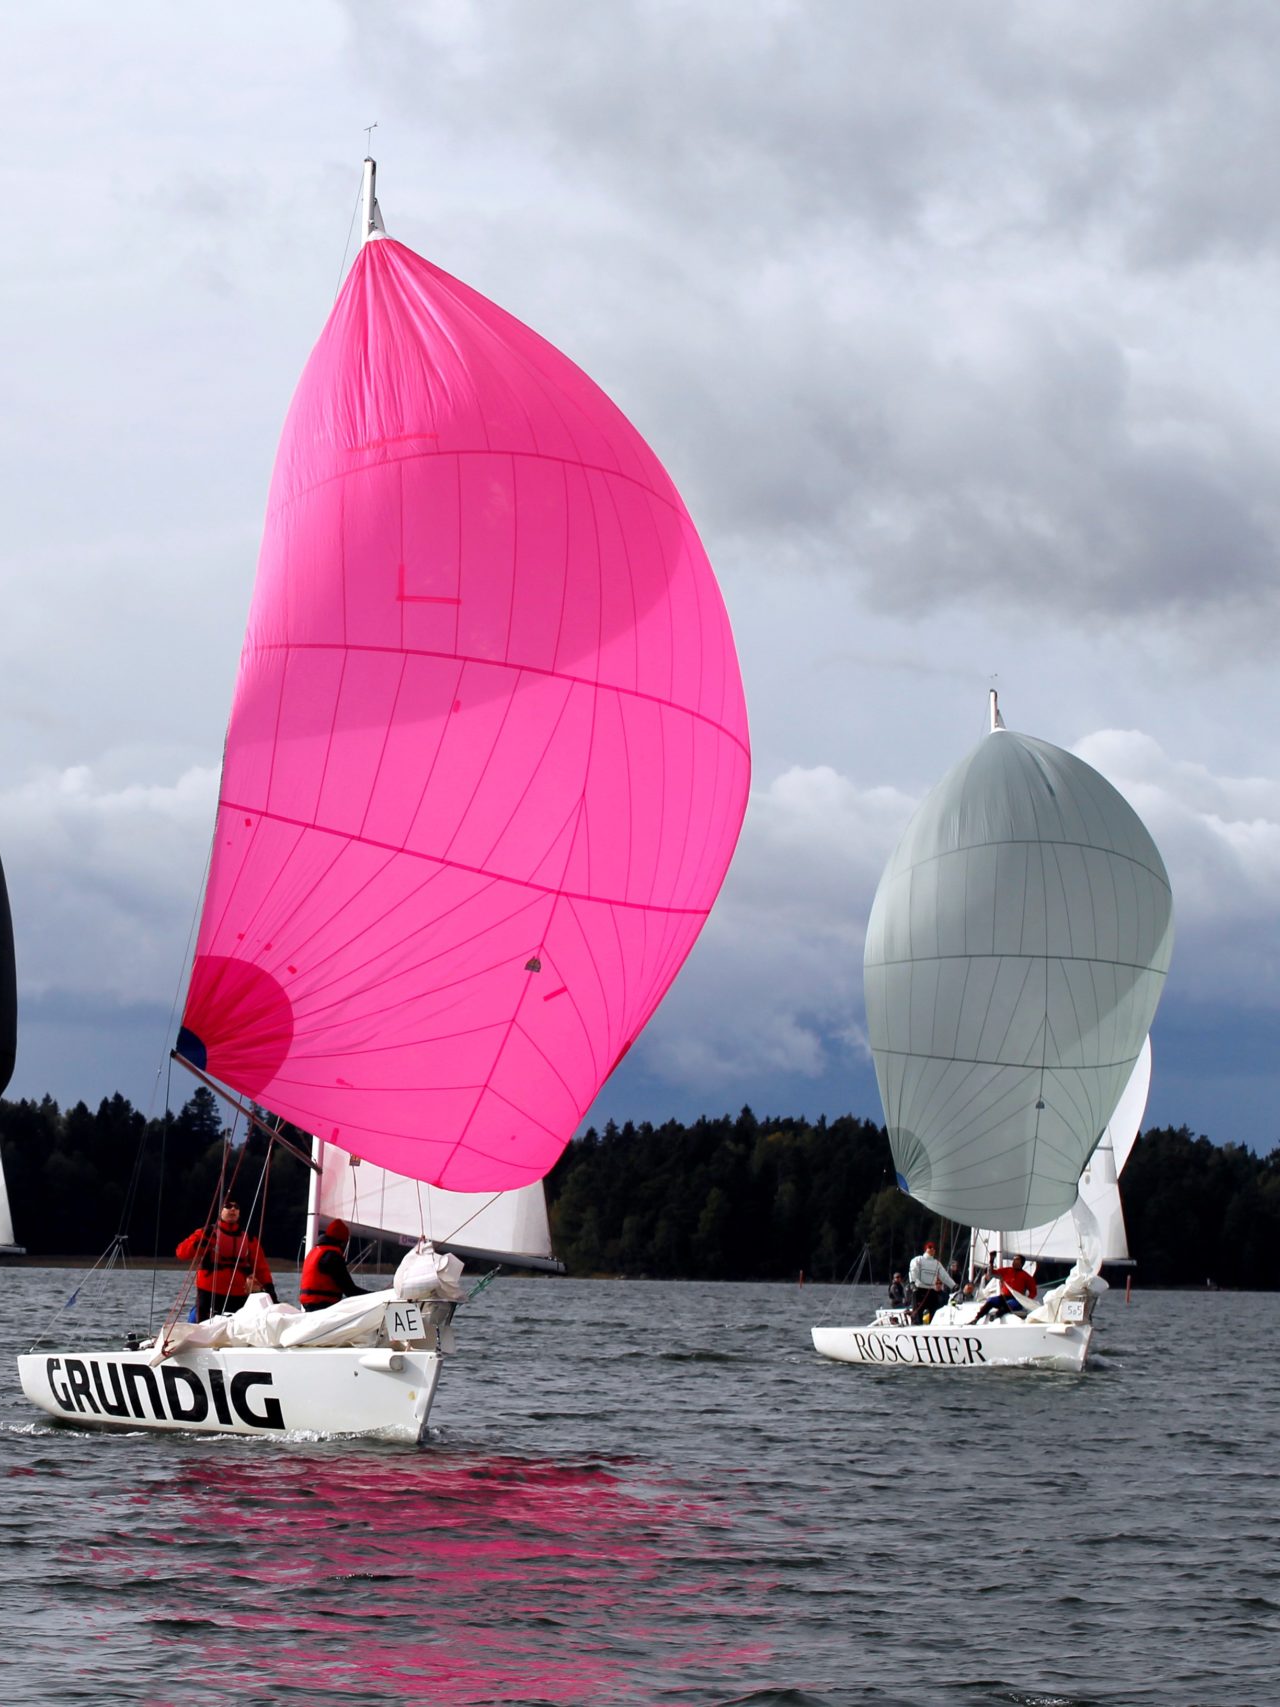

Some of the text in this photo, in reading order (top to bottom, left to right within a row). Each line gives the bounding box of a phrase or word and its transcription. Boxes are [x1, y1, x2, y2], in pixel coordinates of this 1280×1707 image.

[394, 1309, 418, 1332] AE
[853, 1332, 987, 1364] ROSCHIER
[46, 1357, 286, 1430] GRUNDIG
